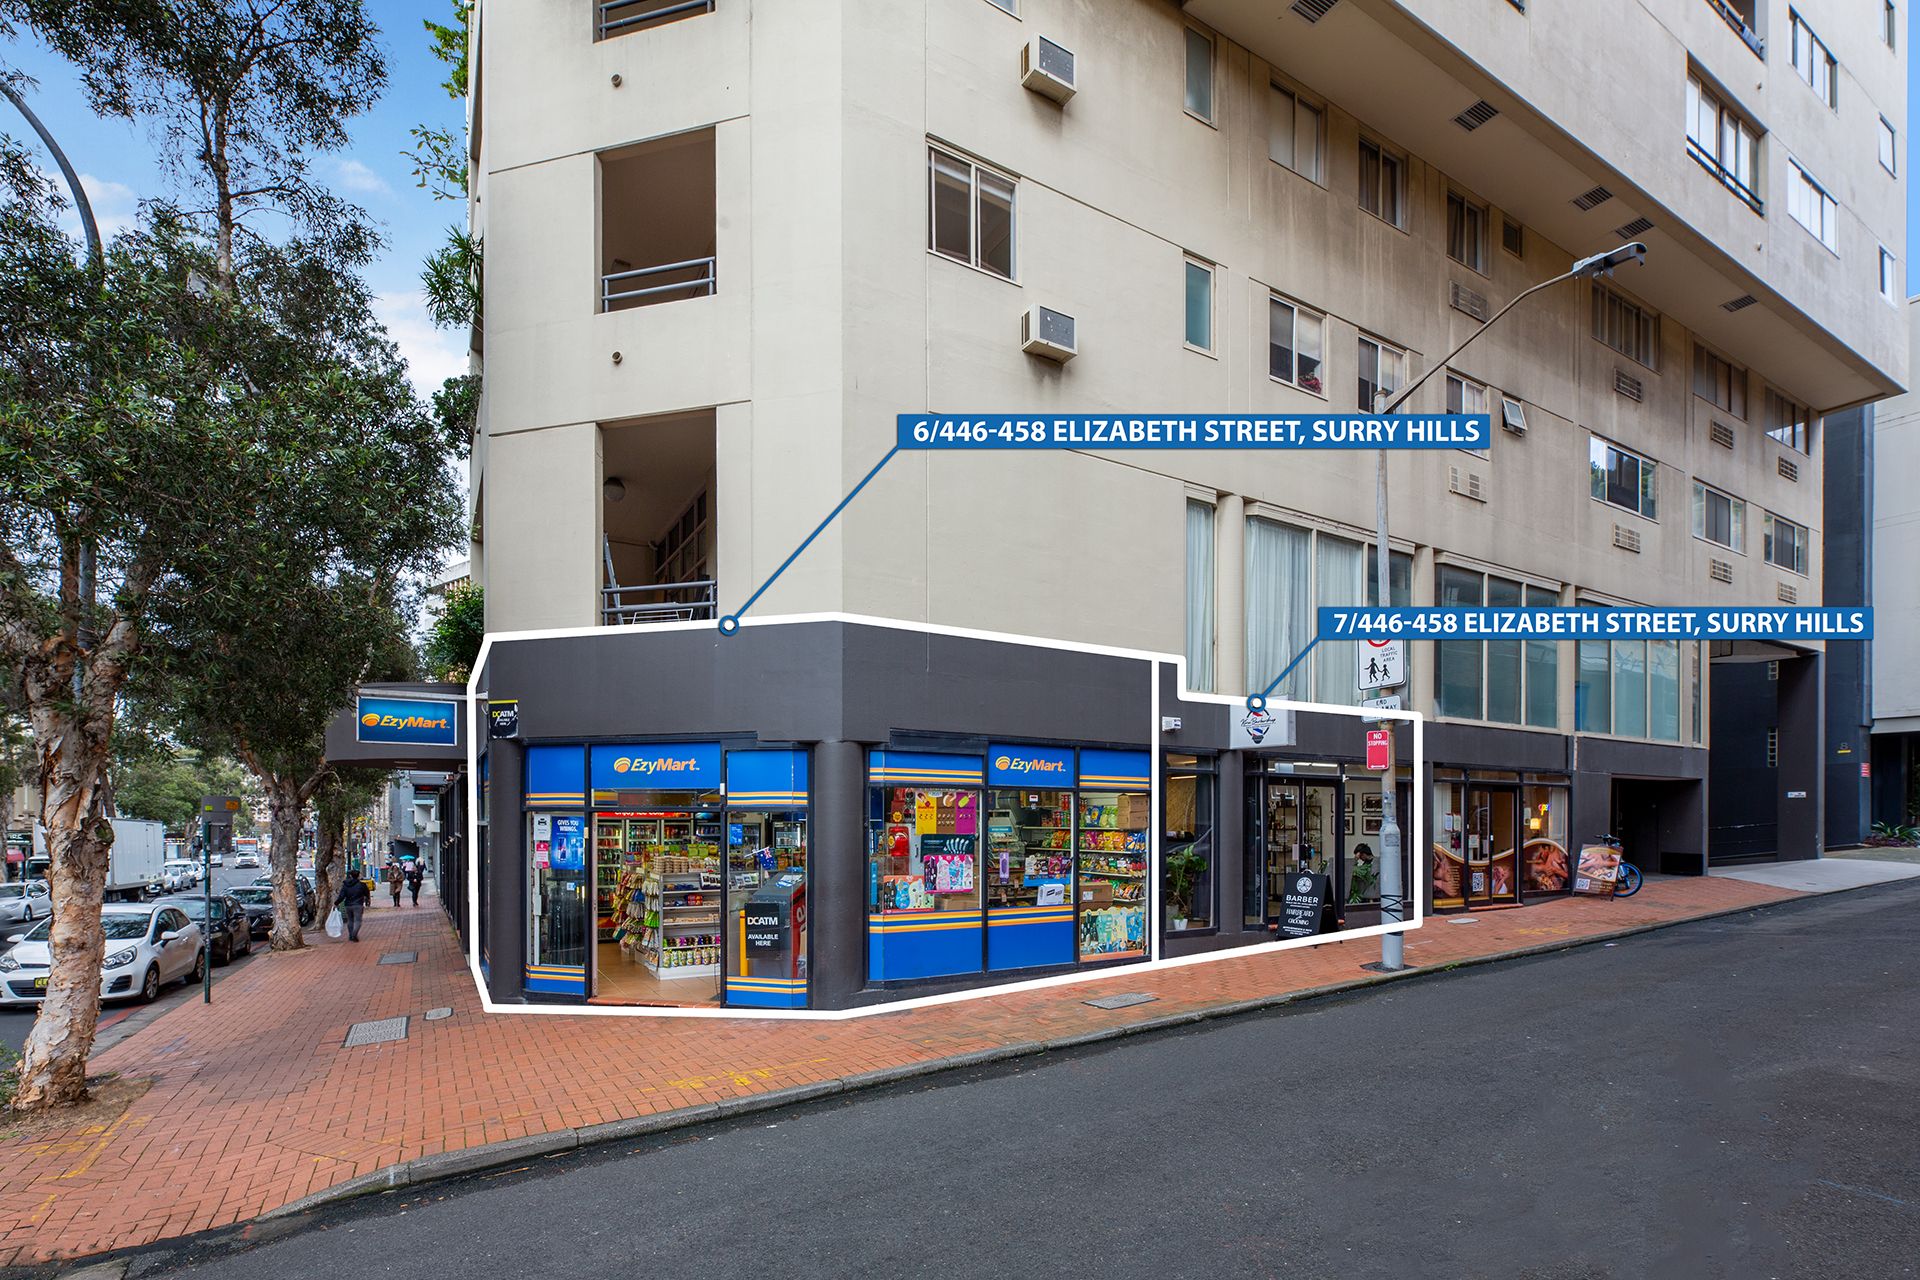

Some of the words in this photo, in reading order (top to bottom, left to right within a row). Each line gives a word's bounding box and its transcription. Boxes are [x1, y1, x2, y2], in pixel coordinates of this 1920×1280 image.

[492, 710, 515, 718] DCATM
[380, 714, 447, 730] EzyMart
[630, 757, 697, 775] EzyMart
[1010, 757, 1064, 774] EzyMart
[1286, 894, 1319, 904] BARBER
[747, 916, 779, 926] DCATM
